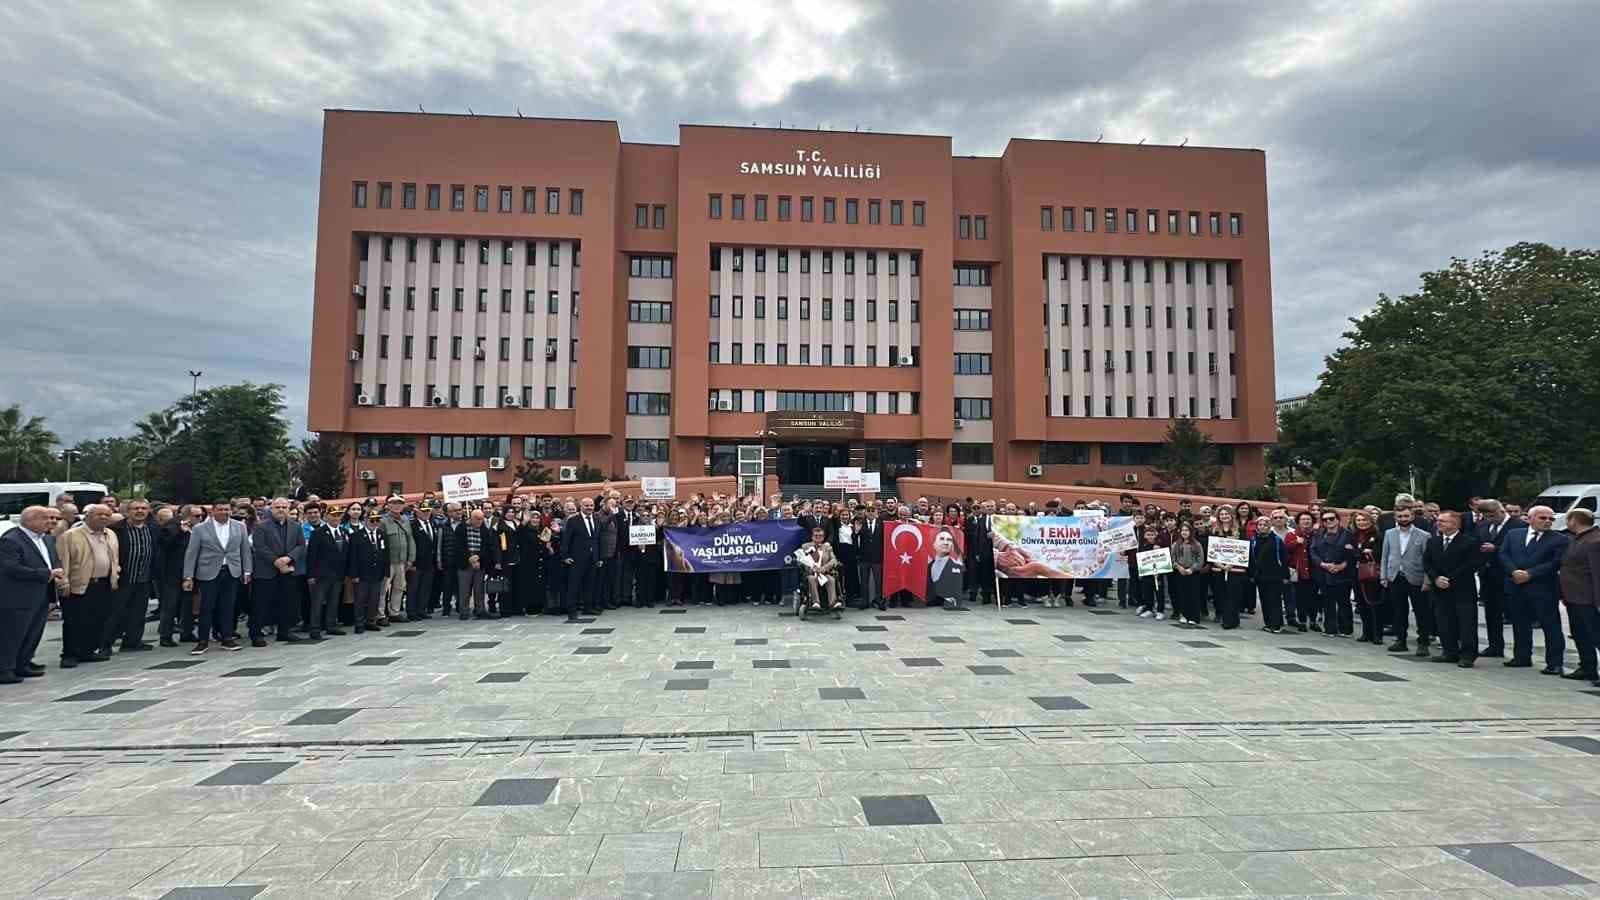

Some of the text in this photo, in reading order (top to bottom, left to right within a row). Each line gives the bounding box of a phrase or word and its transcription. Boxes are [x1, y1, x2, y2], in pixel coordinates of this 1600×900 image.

[796, 150, 827, 162] T.C.
[740, 162, 881, 179] SAMSUN VALİLİĞİ
[1040, 524, 1081, 538] 1 EKİM
[714, 534, 753, 546] DÜNYA
[1021, 536, 1045, 545] DÜNYA
[1046, 538, 1077, 546] YAŞLILAR
[1078, 536, 1098, 545] GÜNÜ
[691, 546, 744, 560] YAŞLILAR
[745, 541, 778, 555] GÜNÜ
